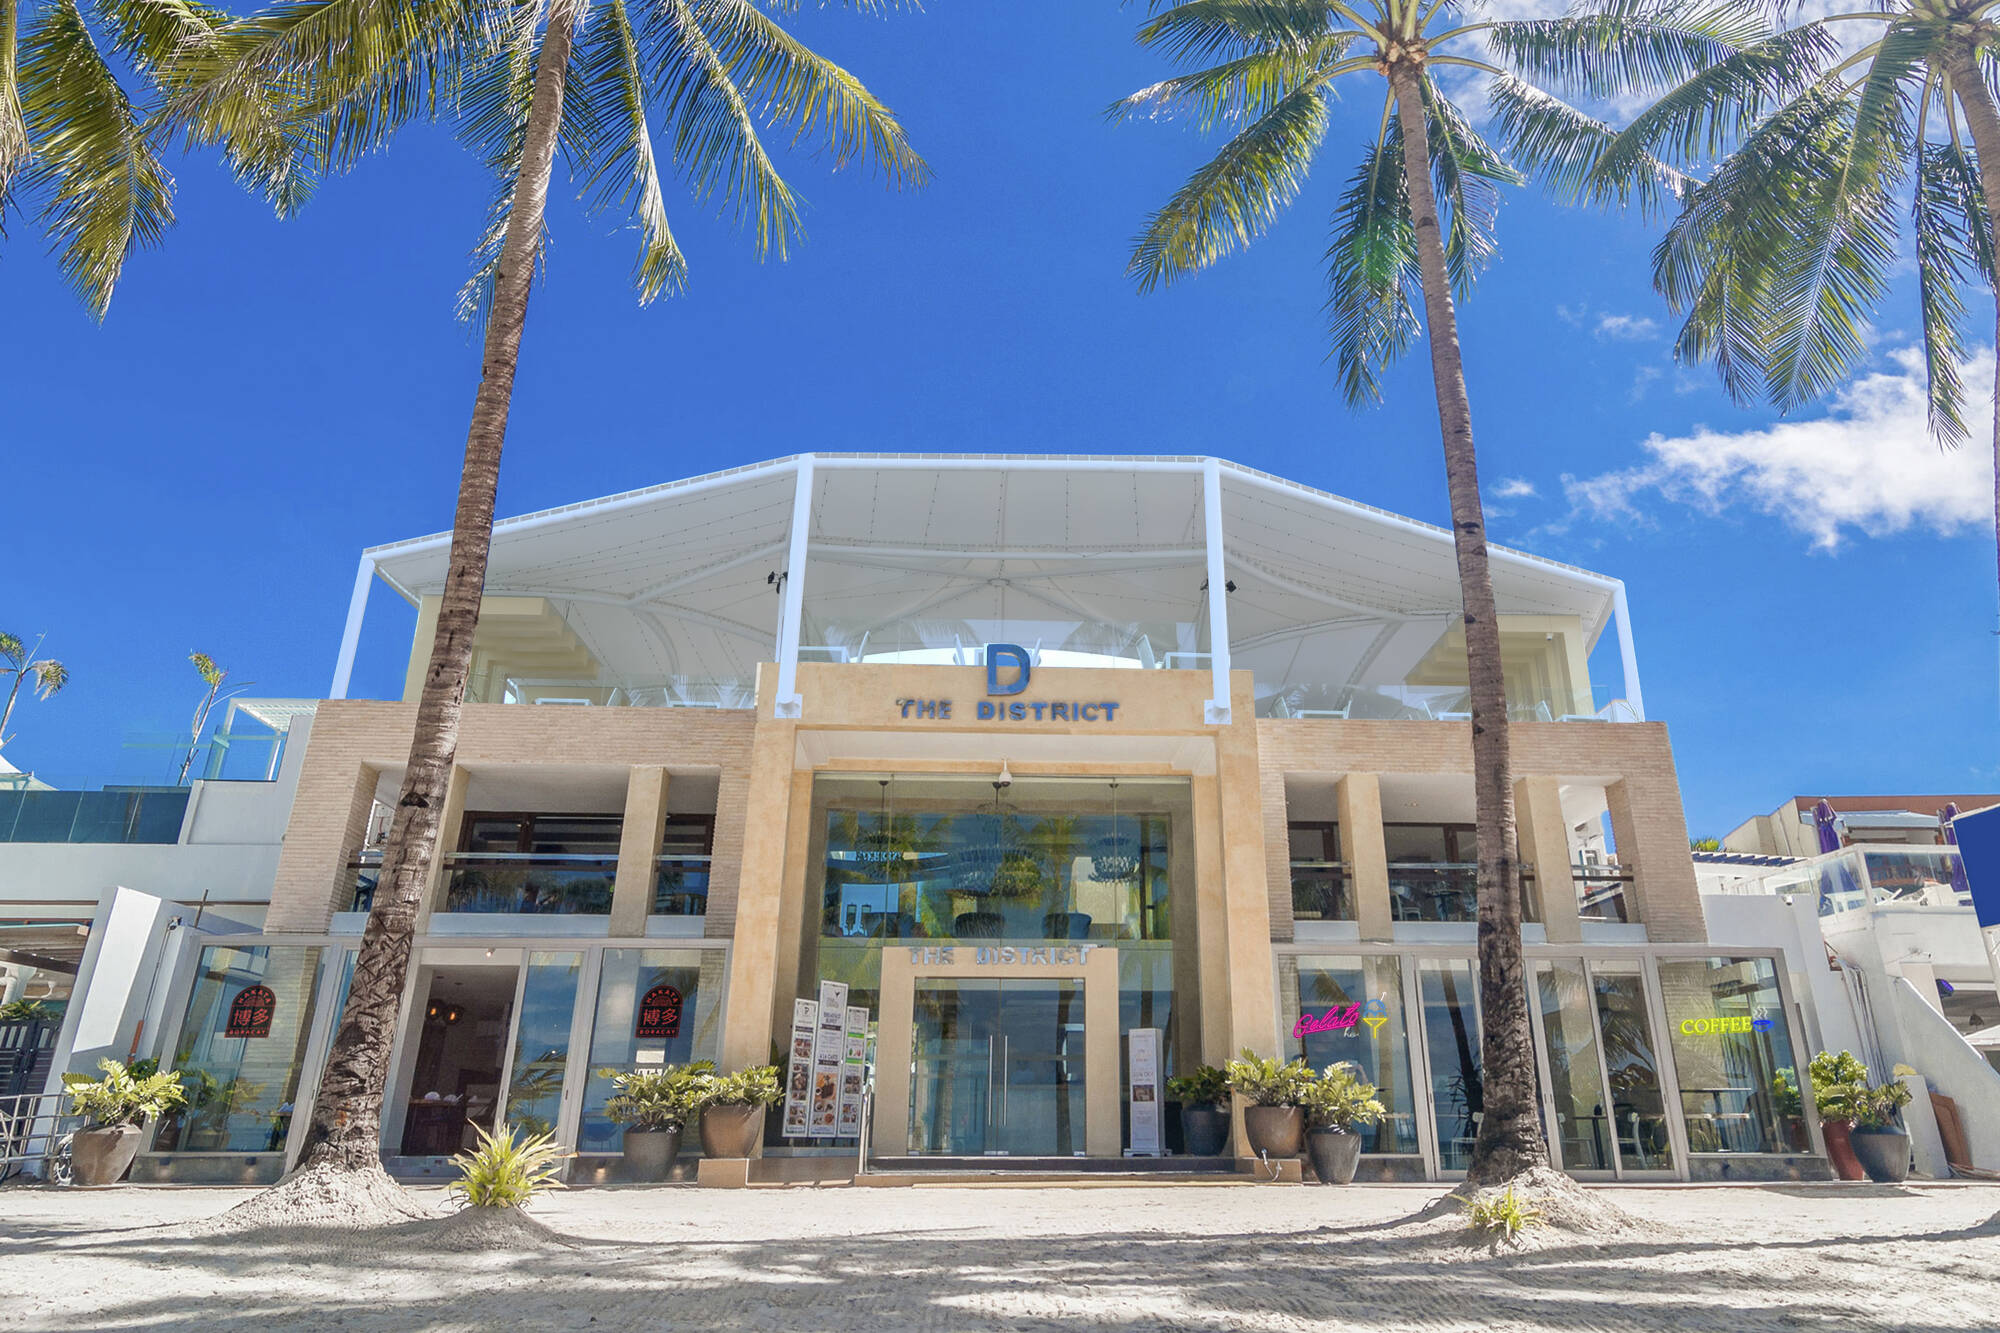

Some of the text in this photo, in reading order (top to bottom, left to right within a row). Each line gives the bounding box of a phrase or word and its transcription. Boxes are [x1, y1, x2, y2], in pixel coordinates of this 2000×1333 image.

[986, 643, 1031, 696] D
[896, 699, 1120, 721] THE DISTRICT
[909, 947, 1091, 966] THE DISTRICT
[233, 1008, 269, 1026] 博多
[643, 1008, 678, 1026] 博多
[1293, 1001, 1361, 1038] Gelato
[1681, 1016, 1753, 1035] COFFEE
